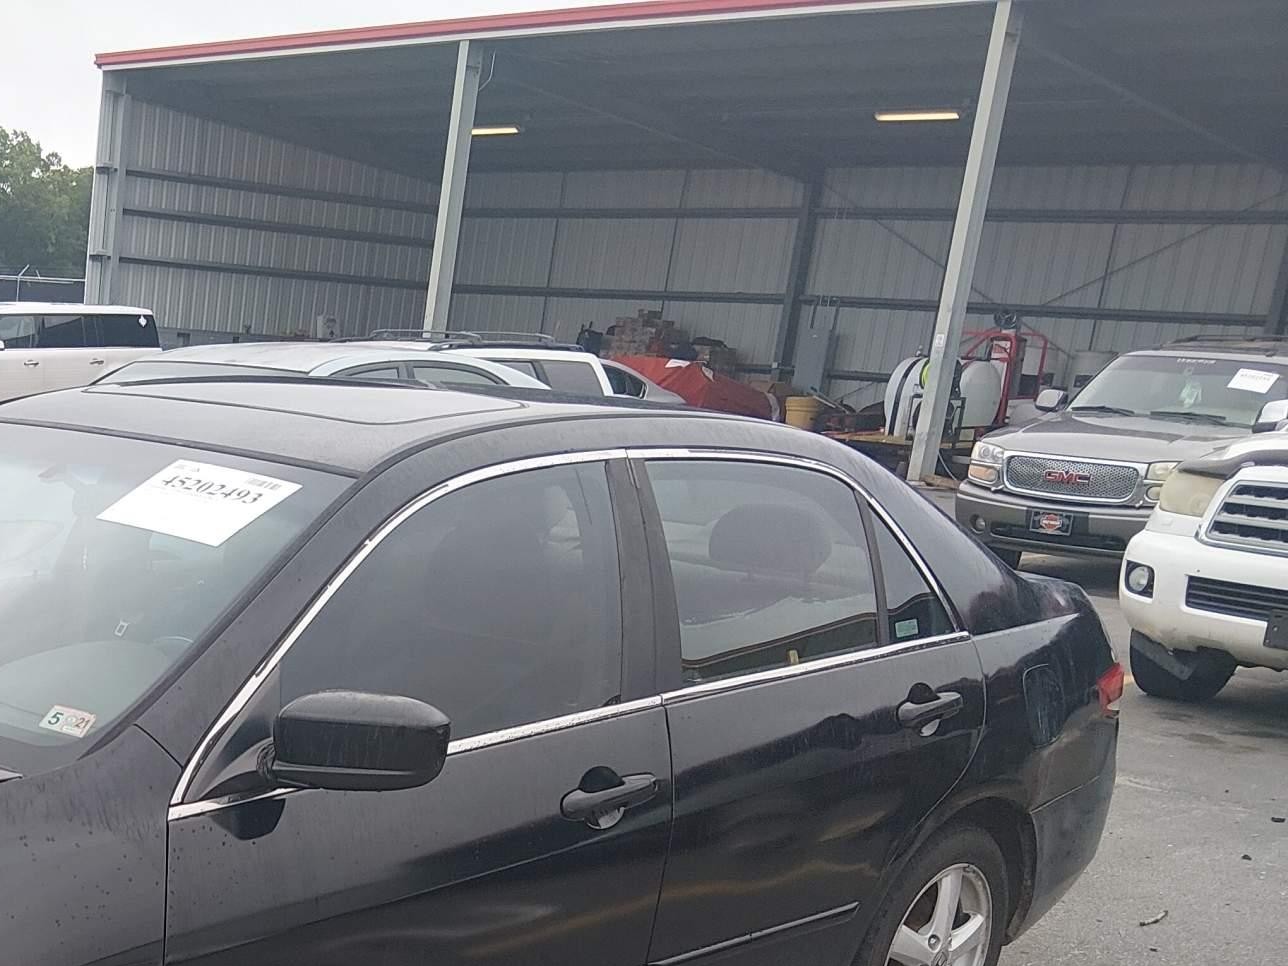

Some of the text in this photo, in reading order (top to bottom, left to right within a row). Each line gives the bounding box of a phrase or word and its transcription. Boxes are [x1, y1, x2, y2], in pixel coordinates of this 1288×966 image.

[1044, 470, 1091, 485] GMC
[161, 474, 264, 505] 45202493
[48, 711, 90, 729] 5 21
